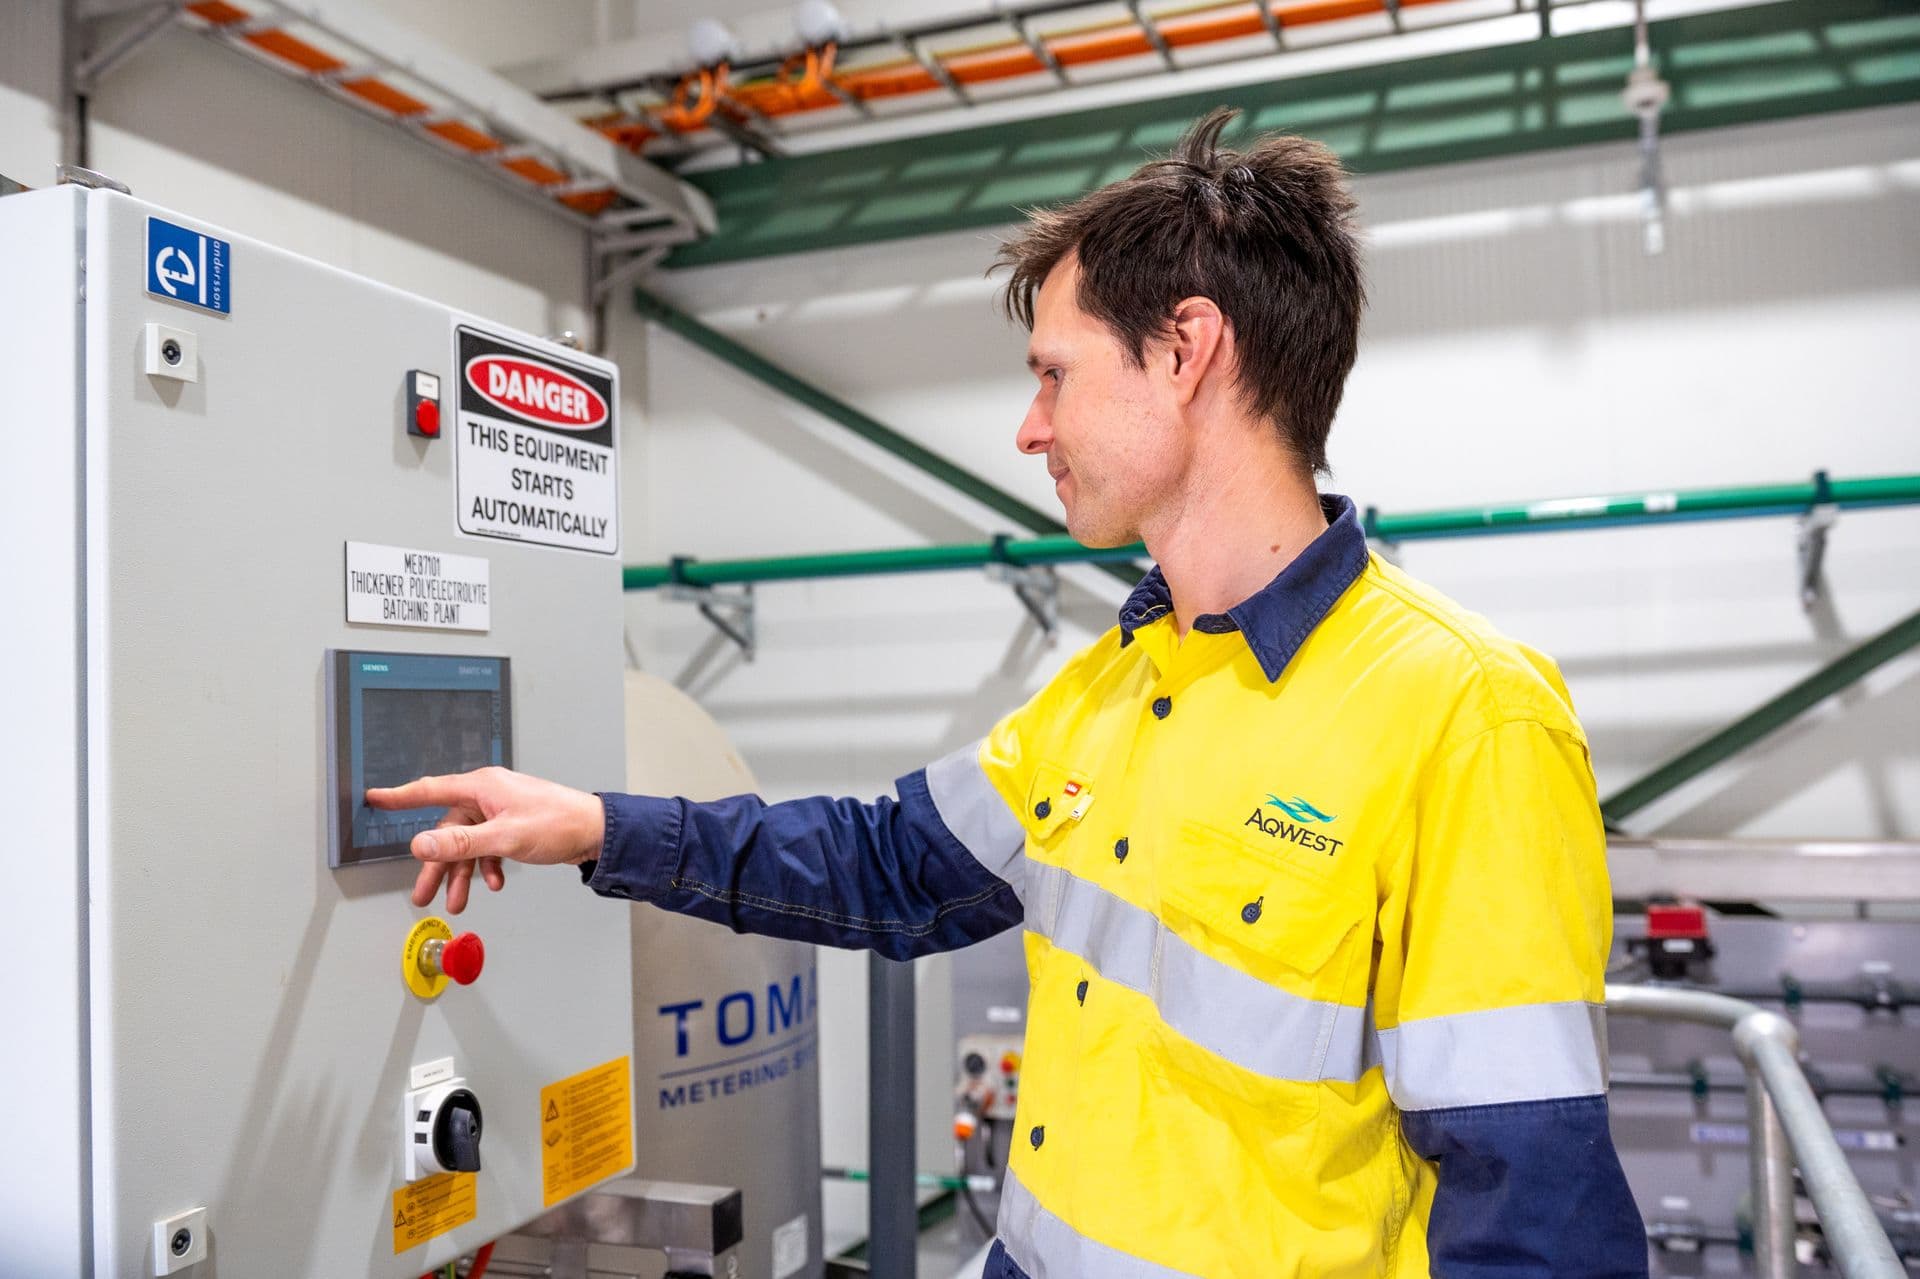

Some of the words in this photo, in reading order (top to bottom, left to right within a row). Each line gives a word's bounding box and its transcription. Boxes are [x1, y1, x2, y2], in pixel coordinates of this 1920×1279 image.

[213, 241, 224, 309] andersson
[488, 363, 590, 421] DANGER
[467, 422, 508, 452] THIS
[514, 434, 608, 475] EQUIPMENT
[511, 468, 574, 500] STARTS
[471, 496, 607, 539] AUTOMATICALLY
[404, 553, 440, 577] ME87101
[351, 570, 404, 597] THICKENER
[409, 577, 487, 604] POLYELECTROLYTE
[383, 598, 428, 622] BATCHING
[433, 602, 460, 624] PLANT
[1244, 808, 1344, 856] AQWEST
[406, 919, 441, 960] EMERGENCY
[659, 1057, 789, 1110] METERING
